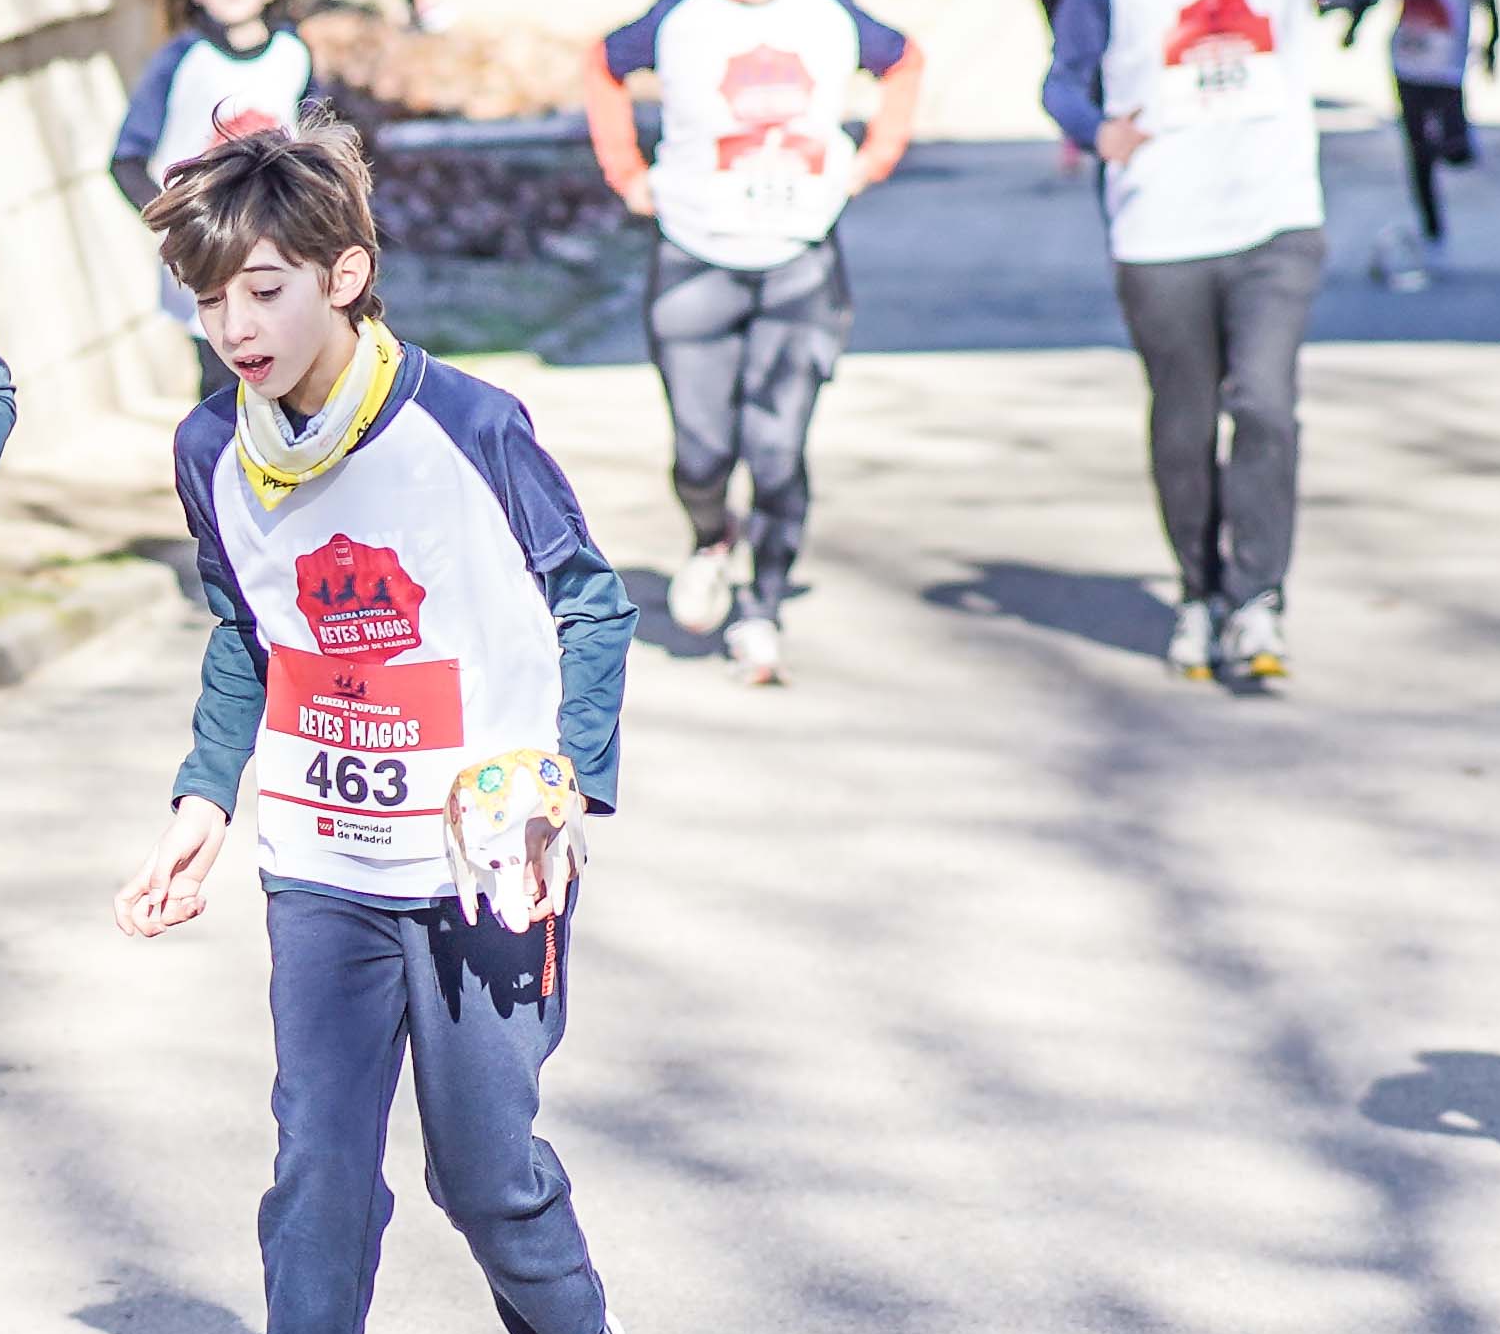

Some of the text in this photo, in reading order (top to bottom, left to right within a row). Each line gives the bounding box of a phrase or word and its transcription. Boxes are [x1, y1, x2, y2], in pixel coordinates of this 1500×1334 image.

[319, 618, 412, 644] REYES MAGOS
[312, 695, 401, 716] CARRERA POPULAR
[299, 705, 420, 748] REYES MAGOS
[306, 750, 409, 807] 463
[337, 819, 392, 833] Comunidad
[337, 831, 392, 845] de Madrid
